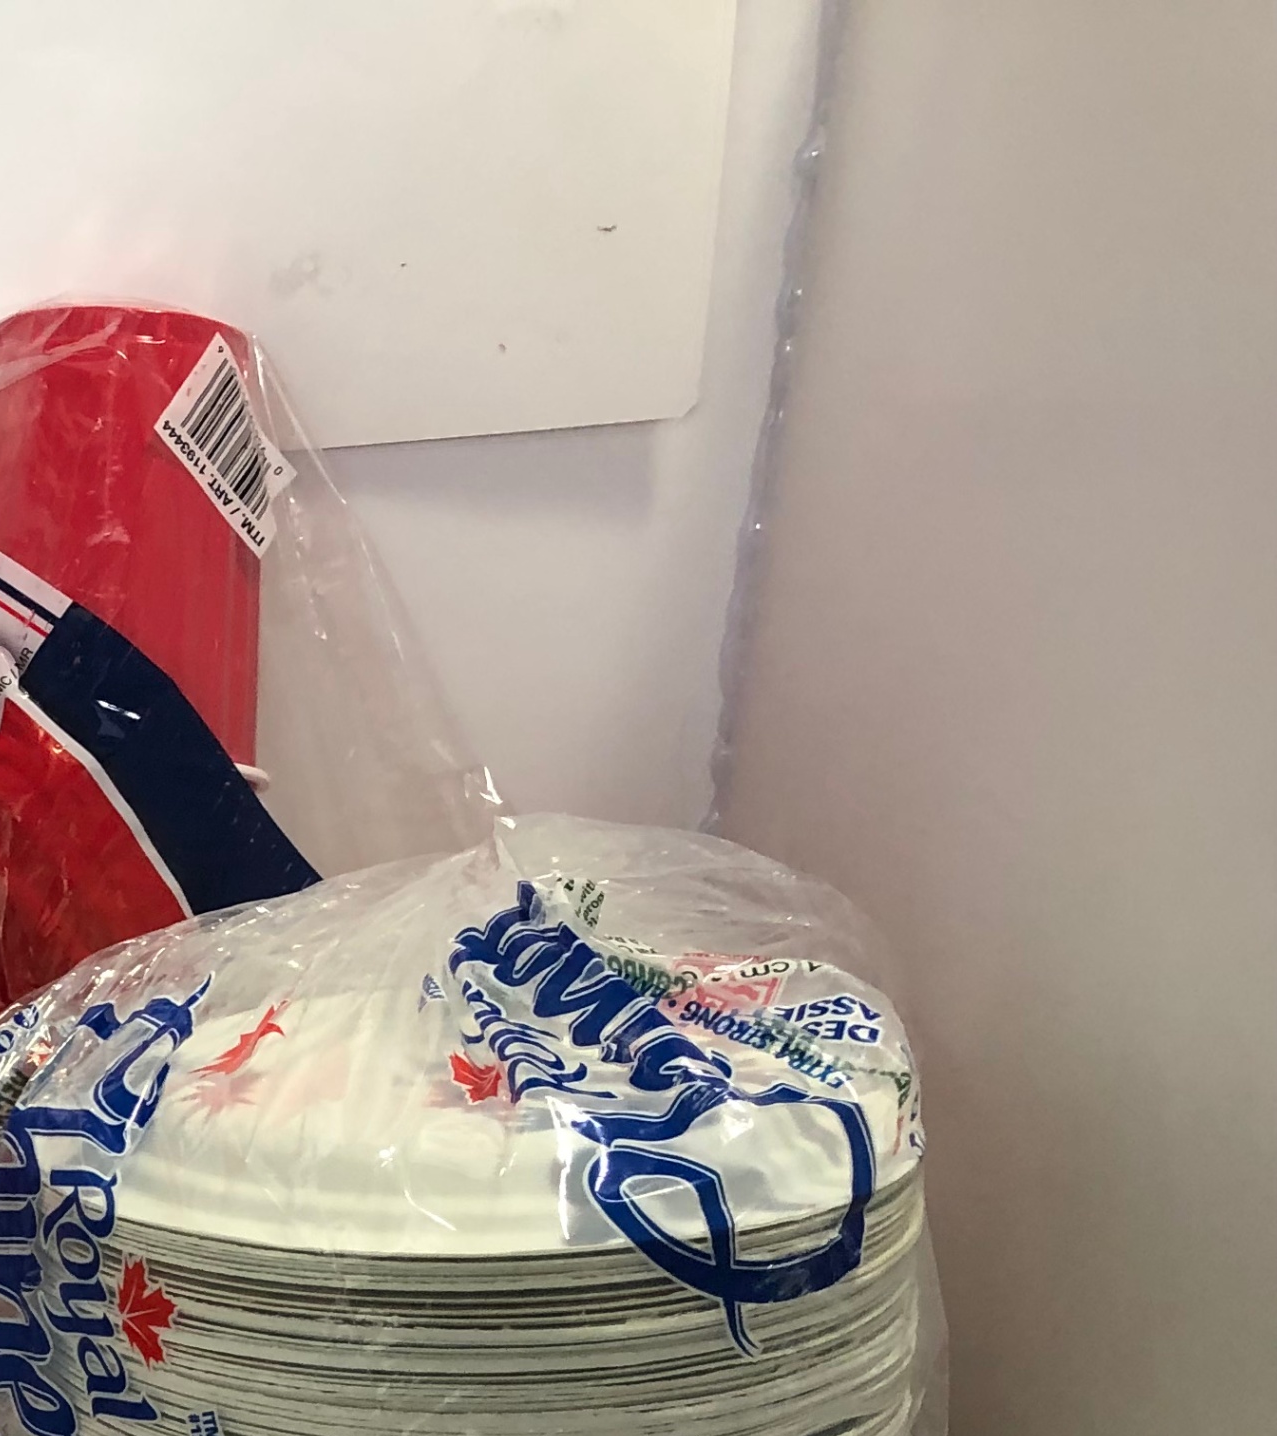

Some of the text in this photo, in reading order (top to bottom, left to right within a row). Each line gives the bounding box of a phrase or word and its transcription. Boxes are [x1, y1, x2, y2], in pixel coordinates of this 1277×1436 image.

[162, 420, 207, 475] 1193444
[207, 473, 233, 506] ART.
[241, 513, 266, 547] ITM.
[15, 647, 33, 670] MR
[680, 999, 773, 1050] STRONG
[44, 1167, 162, 1424] Royal
